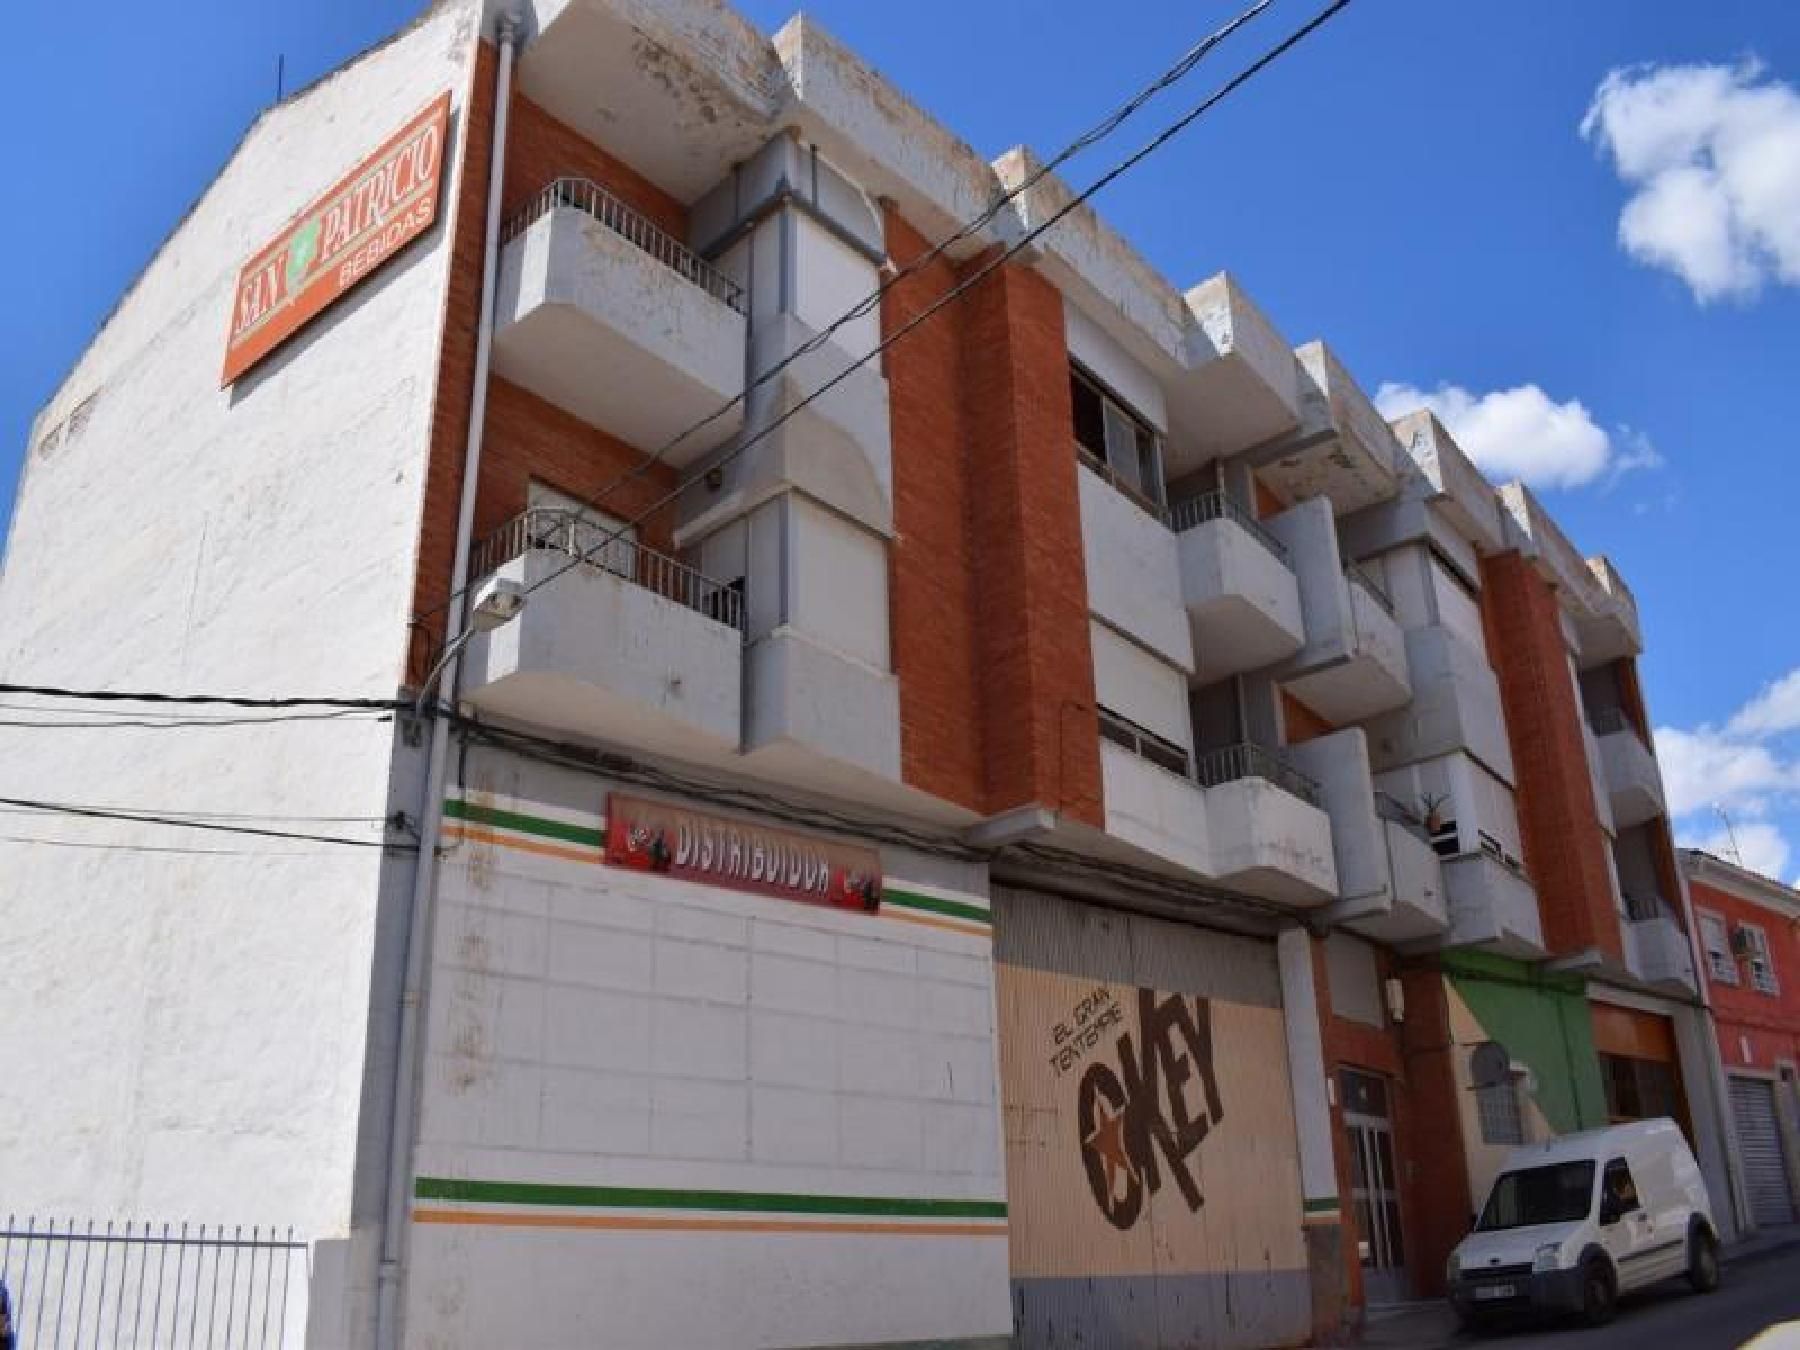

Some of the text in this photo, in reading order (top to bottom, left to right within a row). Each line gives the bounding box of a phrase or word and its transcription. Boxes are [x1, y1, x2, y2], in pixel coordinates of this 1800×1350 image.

[235, 125, 439, 334] SAN PATRICIO
[339, 197, 432, 289] BEBIDAS
[675, 822, 830, 893] DISTRIBUIDOR
[1053, 987, 1110, 1045] EL GRAN
[1078, 987, 1224, 1231] OKEY
